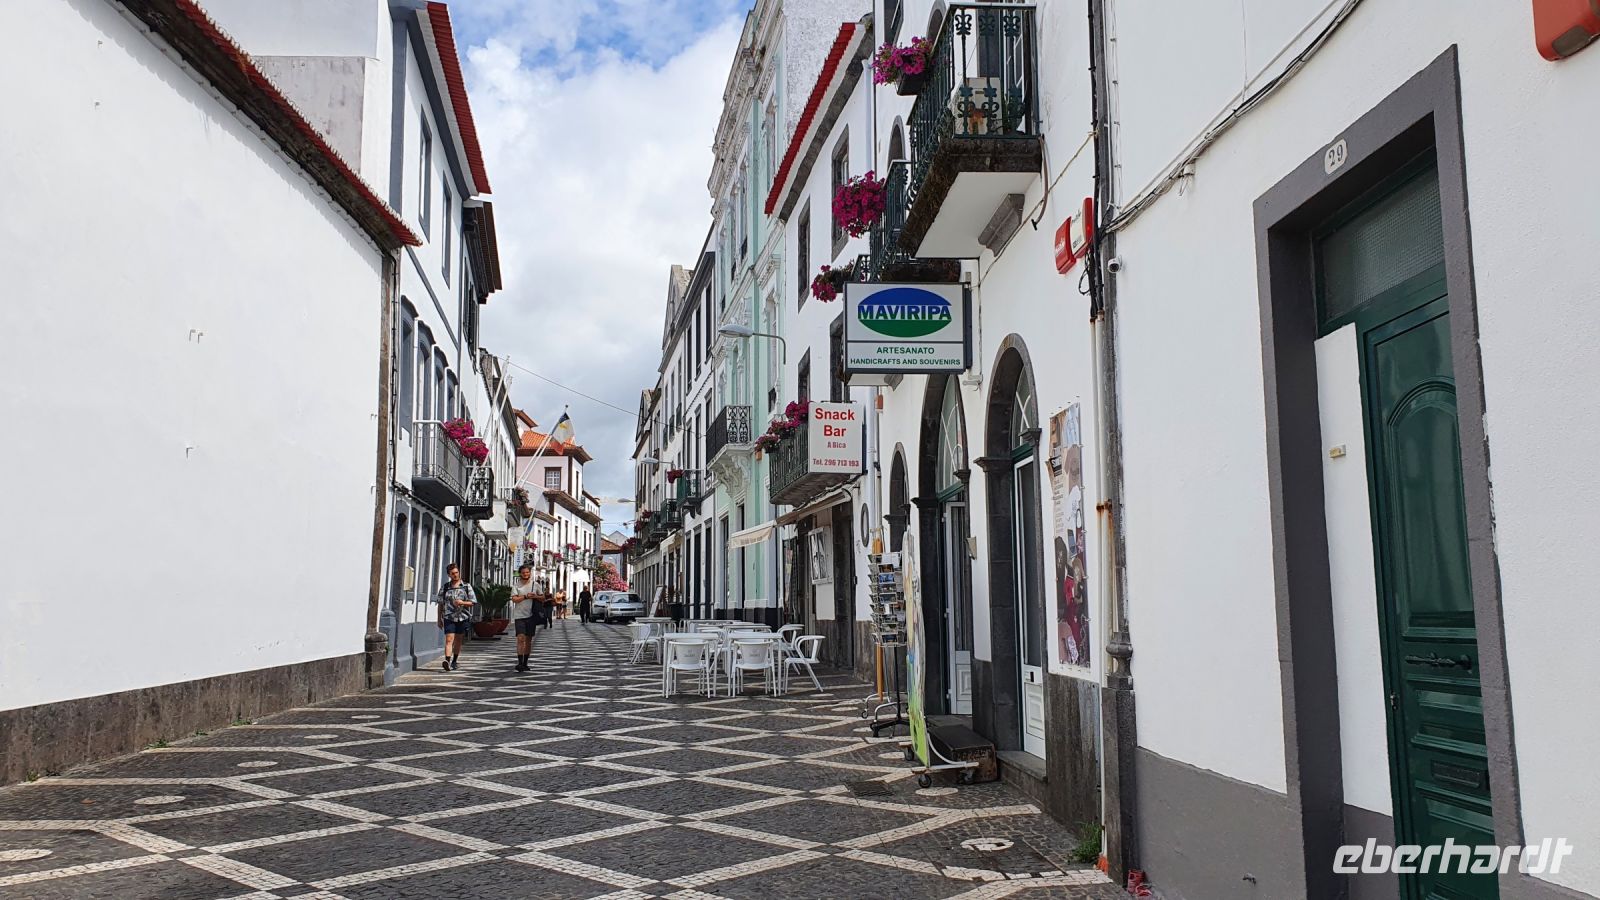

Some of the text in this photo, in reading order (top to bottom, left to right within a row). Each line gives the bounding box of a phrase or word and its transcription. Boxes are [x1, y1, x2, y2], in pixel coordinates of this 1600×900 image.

[1328, 144, 1343, 167] 29
[858, 305, 952, 320] MAVIRIPA
[815, 407, 855, 421] Snack
[823, 424, 847, 437] Bar
[812, 458, 823, 466] Tel.
